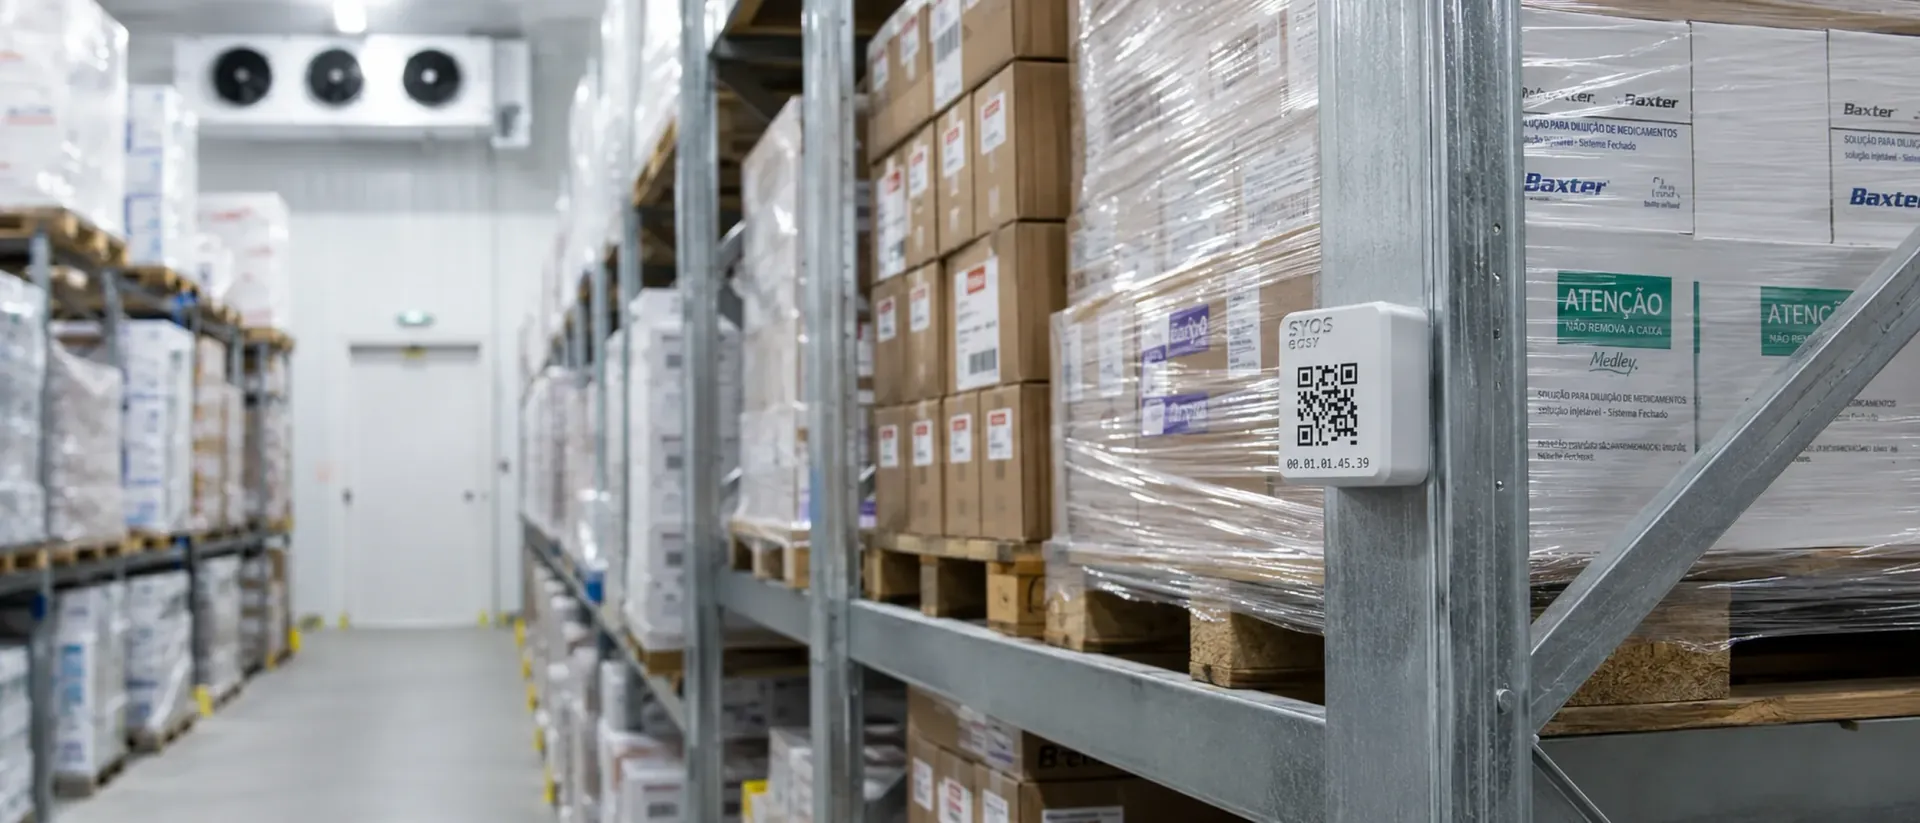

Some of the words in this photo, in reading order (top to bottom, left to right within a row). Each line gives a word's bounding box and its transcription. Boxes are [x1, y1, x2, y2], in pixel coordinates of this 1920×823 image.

[1843, 102, 1895, 118] Baxter
[1550, 120, 1570, 131] PARA
[1605, 125, 1616, 135] DE
[1617, 125, 1678, 138] MEDICAMENTOS
[1525, 172, 1607, 196] Baxter
[1564, 287, 1663, 319] ATENÇÃO
[1565, 319, 1587, 333] NÃO
[1588, 322, 1627, 334] REMOVA
[1628, 325, 1635, 334] A
[1636, 325, 1663, 336] CAIXA
[1288, 336, 1320, 350] easy
[1571, 391, 1590, 401] PARA
[1607, 407, 1637, 418] Sistema
[1638, 409, 1669, 419] Fechado
[1286, 457, 1370, 470] 00.01.01.45.39
